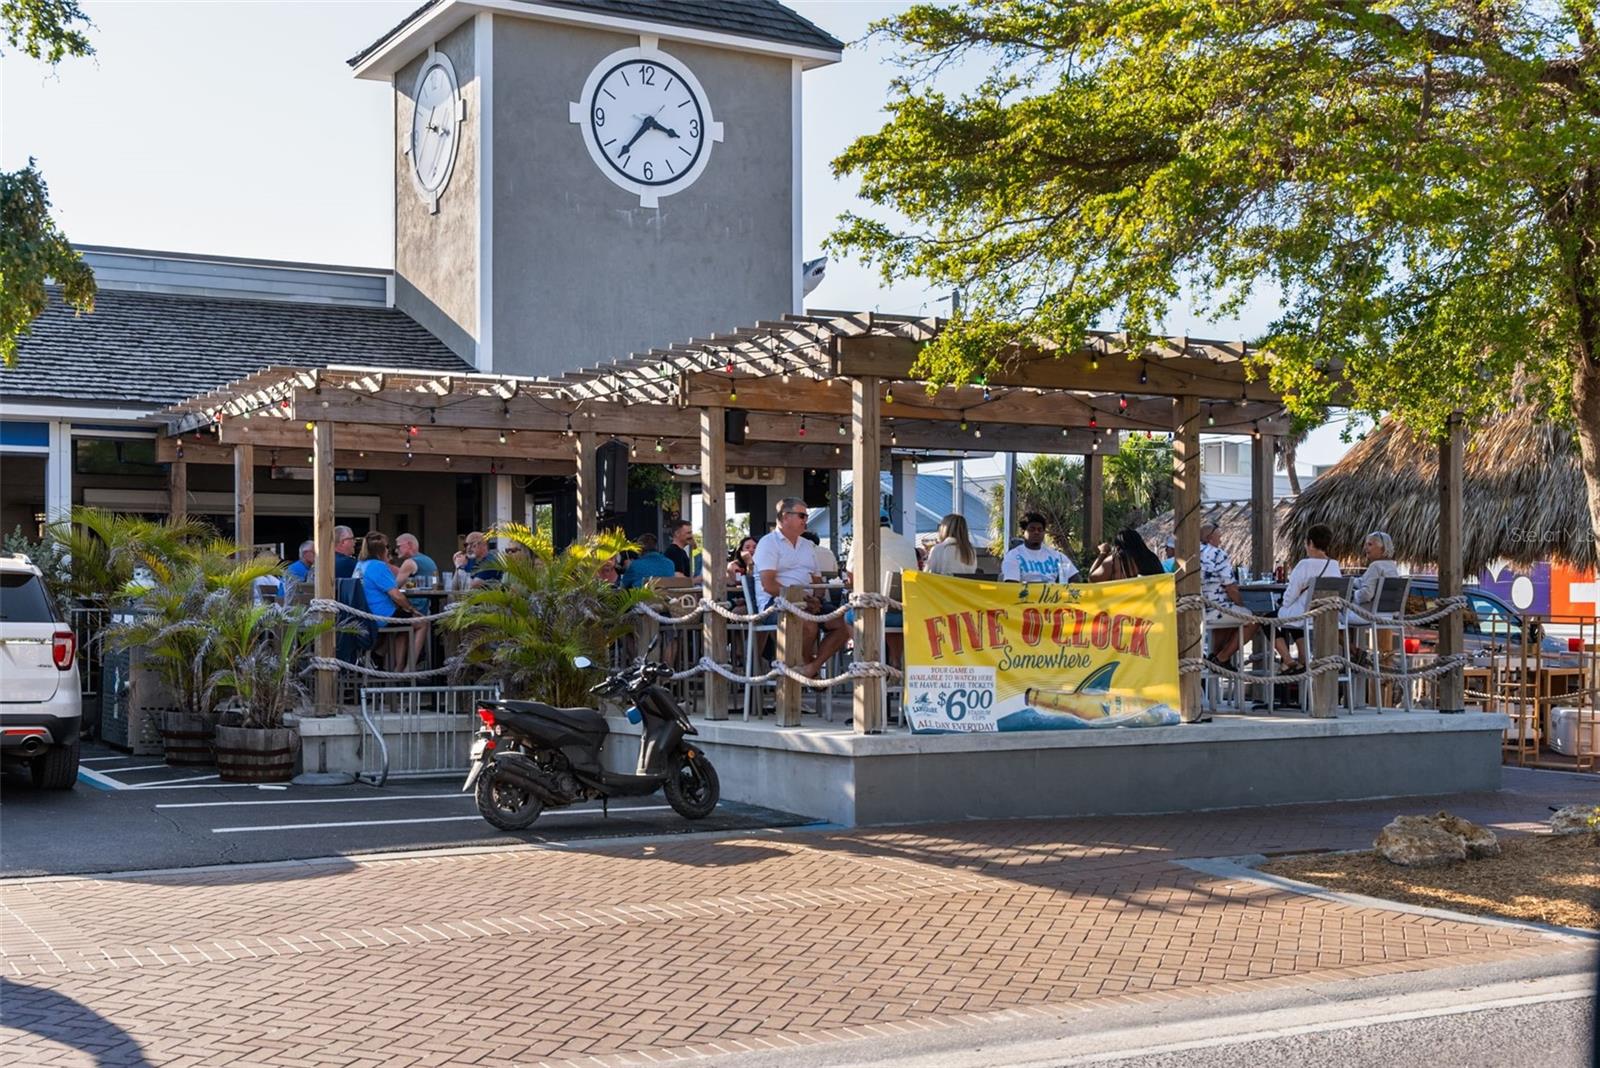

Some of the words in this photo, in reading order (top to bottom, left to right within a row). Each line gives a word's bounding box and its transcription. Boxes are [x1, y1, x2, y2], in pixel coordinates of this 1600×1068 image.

[639, 65, 655, 86] 12
[595, 107, 605, 127] 9
[689, 119, 699, 138] 3
[643, 161, 654, 181] 6
[725, 464, 775, 481] UB
[924, 608, 1009, 660] FIVE
[1021, 607, 1154, 659] O'CLOCK
[998, 645, 1092, 671] Somewhere
[917, 719, 934, 729] ALL
[935, 721, 951, 729] DAY
[952, 722, 995, 731] EVERYDAY
